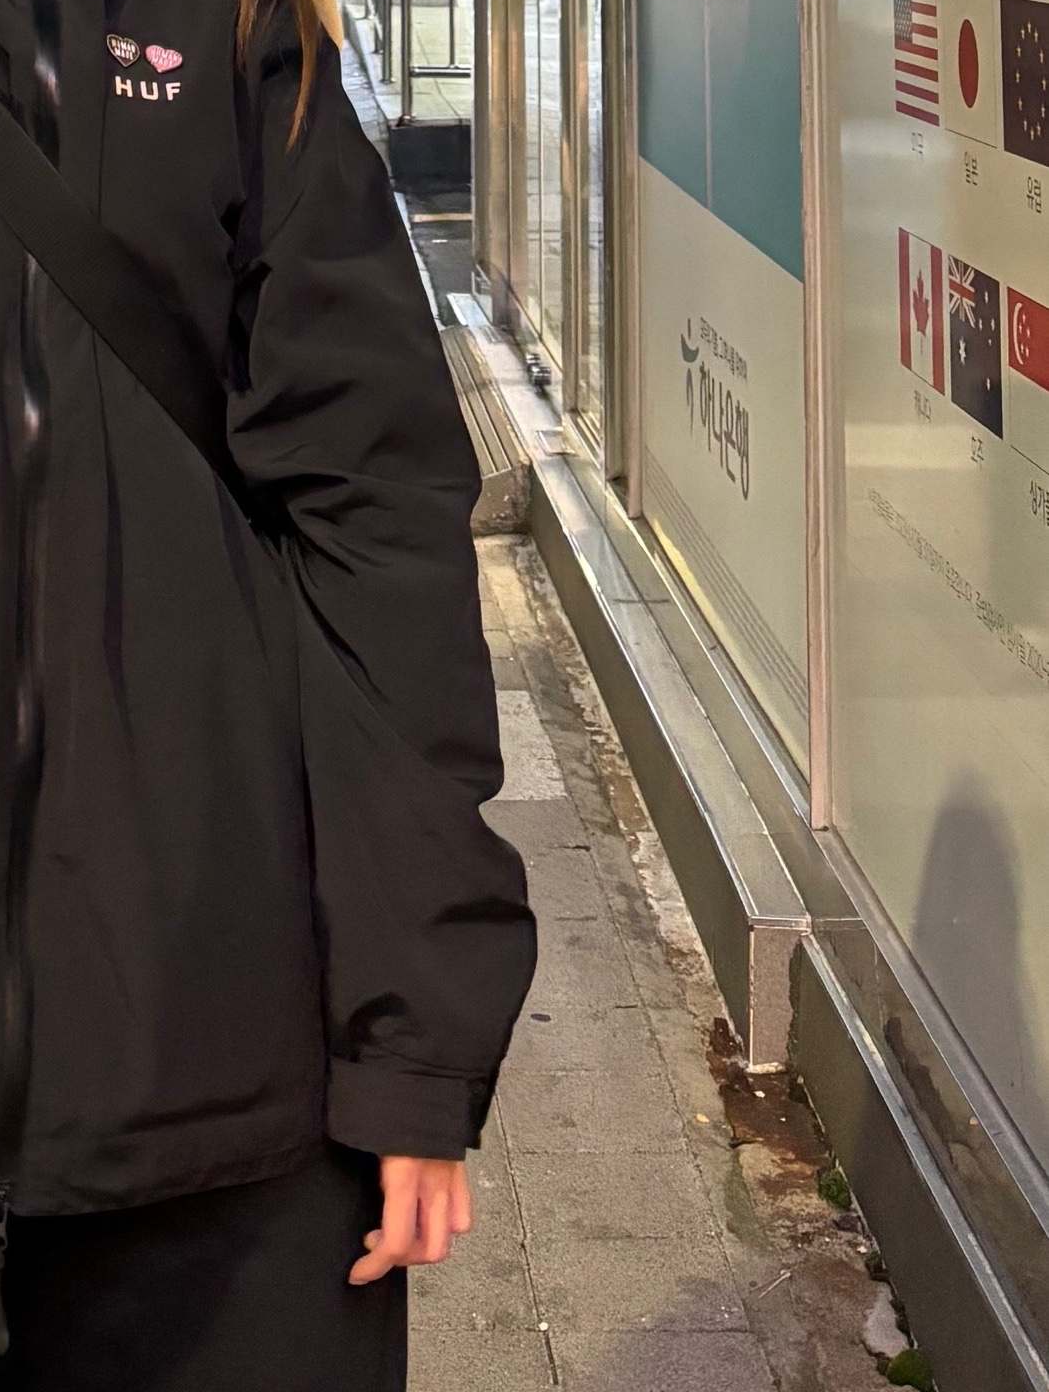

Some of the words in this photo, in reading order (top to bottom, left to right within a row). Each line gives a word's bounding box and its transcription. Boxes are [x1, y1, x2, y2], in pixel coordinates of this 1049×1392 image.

[115, 75, 181, 101] HUF
[964, 151, 979, 187] 일본
[1026, 176, 1042, 214] 유럽
[699, 360, 750, 502] 하나은행
